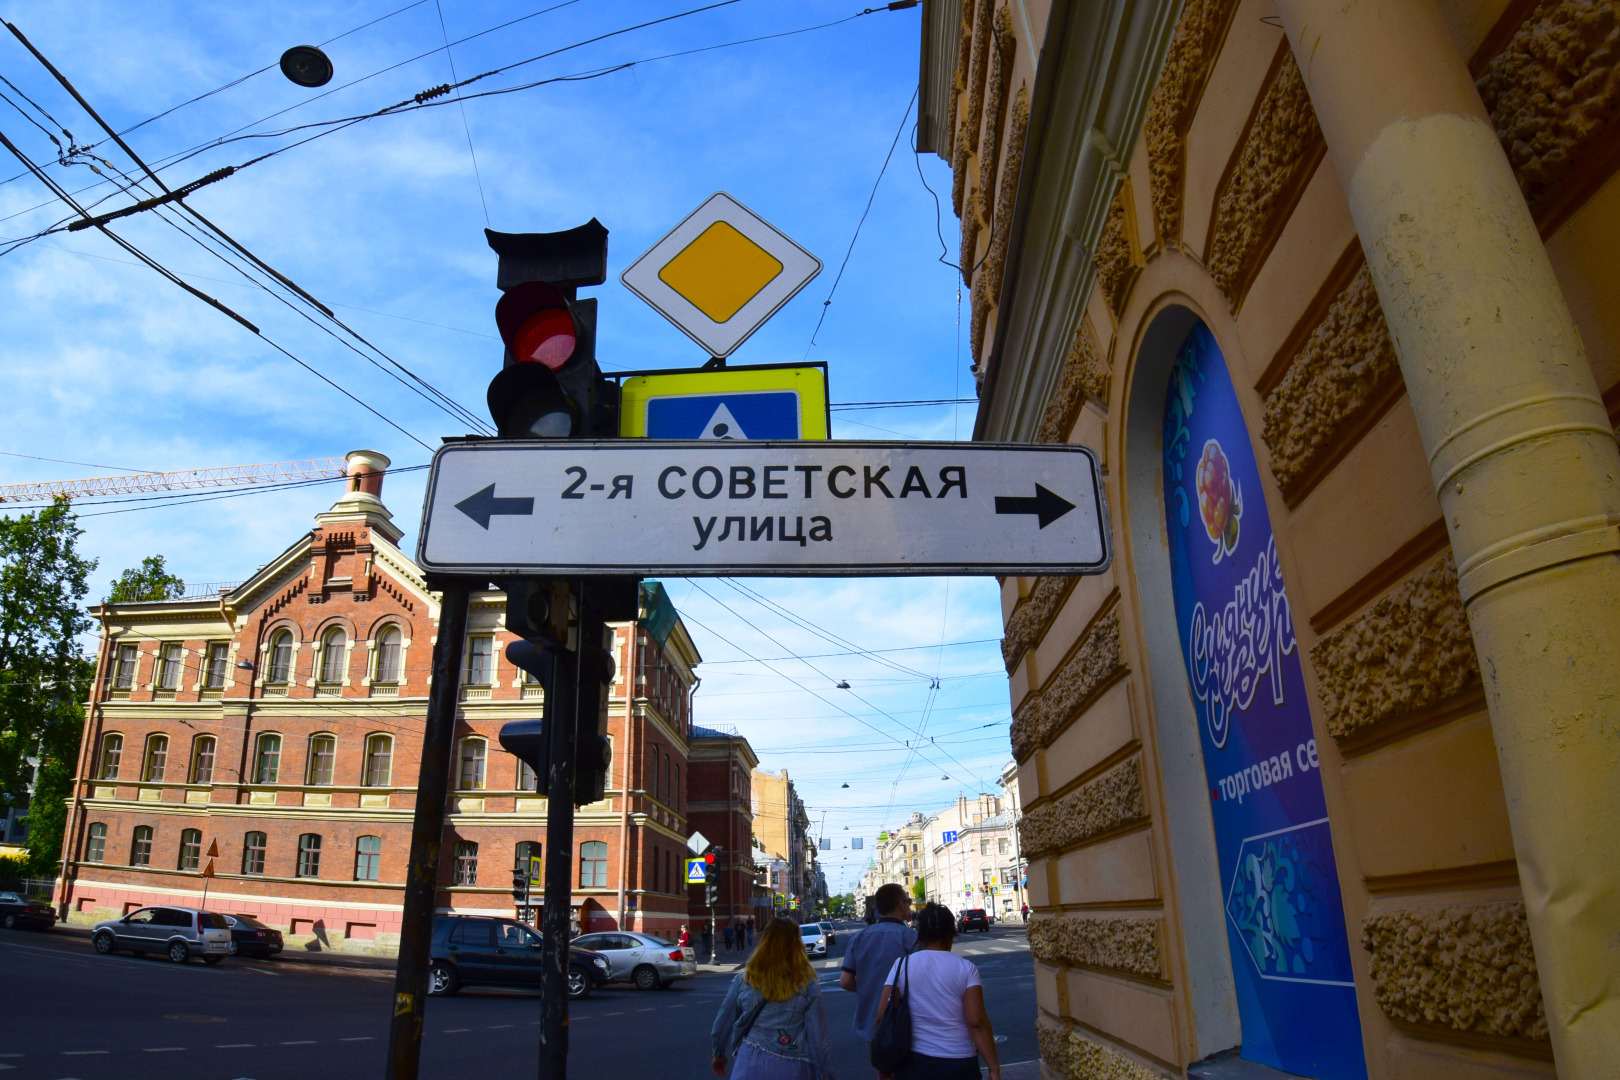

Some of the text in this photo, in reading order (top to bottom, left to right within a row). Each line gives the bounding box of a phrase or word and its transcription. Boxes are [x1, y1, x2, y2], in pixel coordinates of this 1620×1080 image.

[561, 464, 968, 500] 2-я СОВЕТСКАЯ
[692, 515, 834, 551] улица
[1218, 750, 1293, 805] торговая
